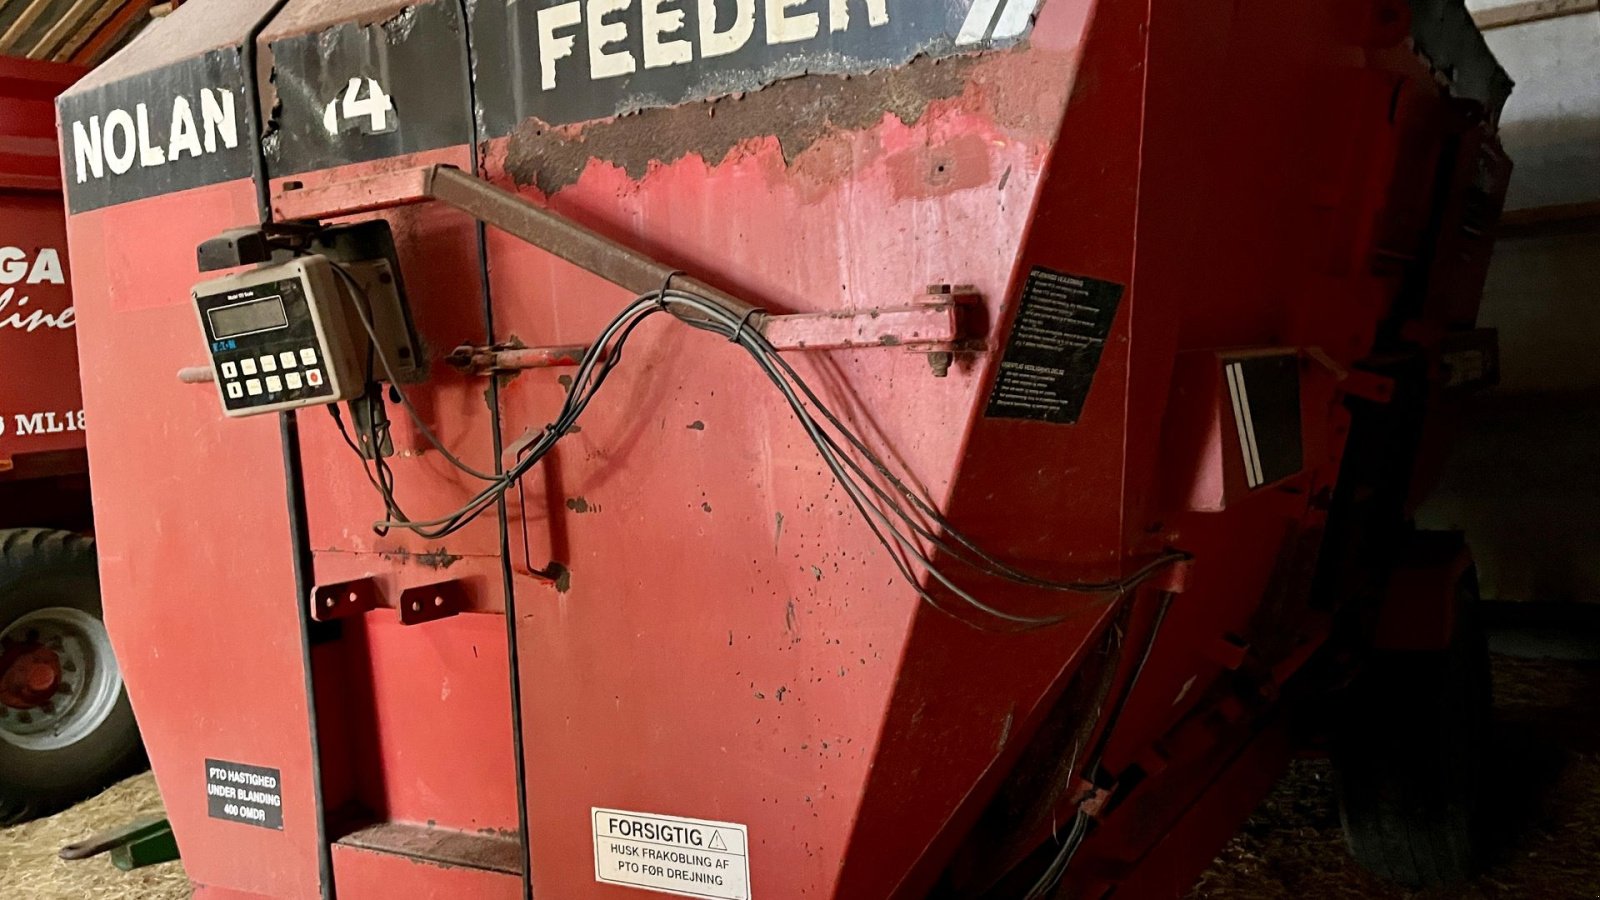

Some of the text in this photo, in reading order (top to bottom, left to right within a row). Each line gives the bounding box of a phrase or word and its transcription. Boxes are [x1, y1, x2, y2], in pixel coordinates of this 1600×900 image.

[73, 88, 238, 183] NOLAN
[0, 246, 65, 285] GA
[209, 767, 276, 788] PTO HASTIGHED
[207, 783, 280, 806] UNDER BLANDING
[239, 805, 266, 821] OMDR
[609, 818, 703, 846] FORSIGTIG
[610, 843, 730, 870] HUSK FRAKOBLING AF
[618, 860, 724, 886] PTO FØR DREJNING
